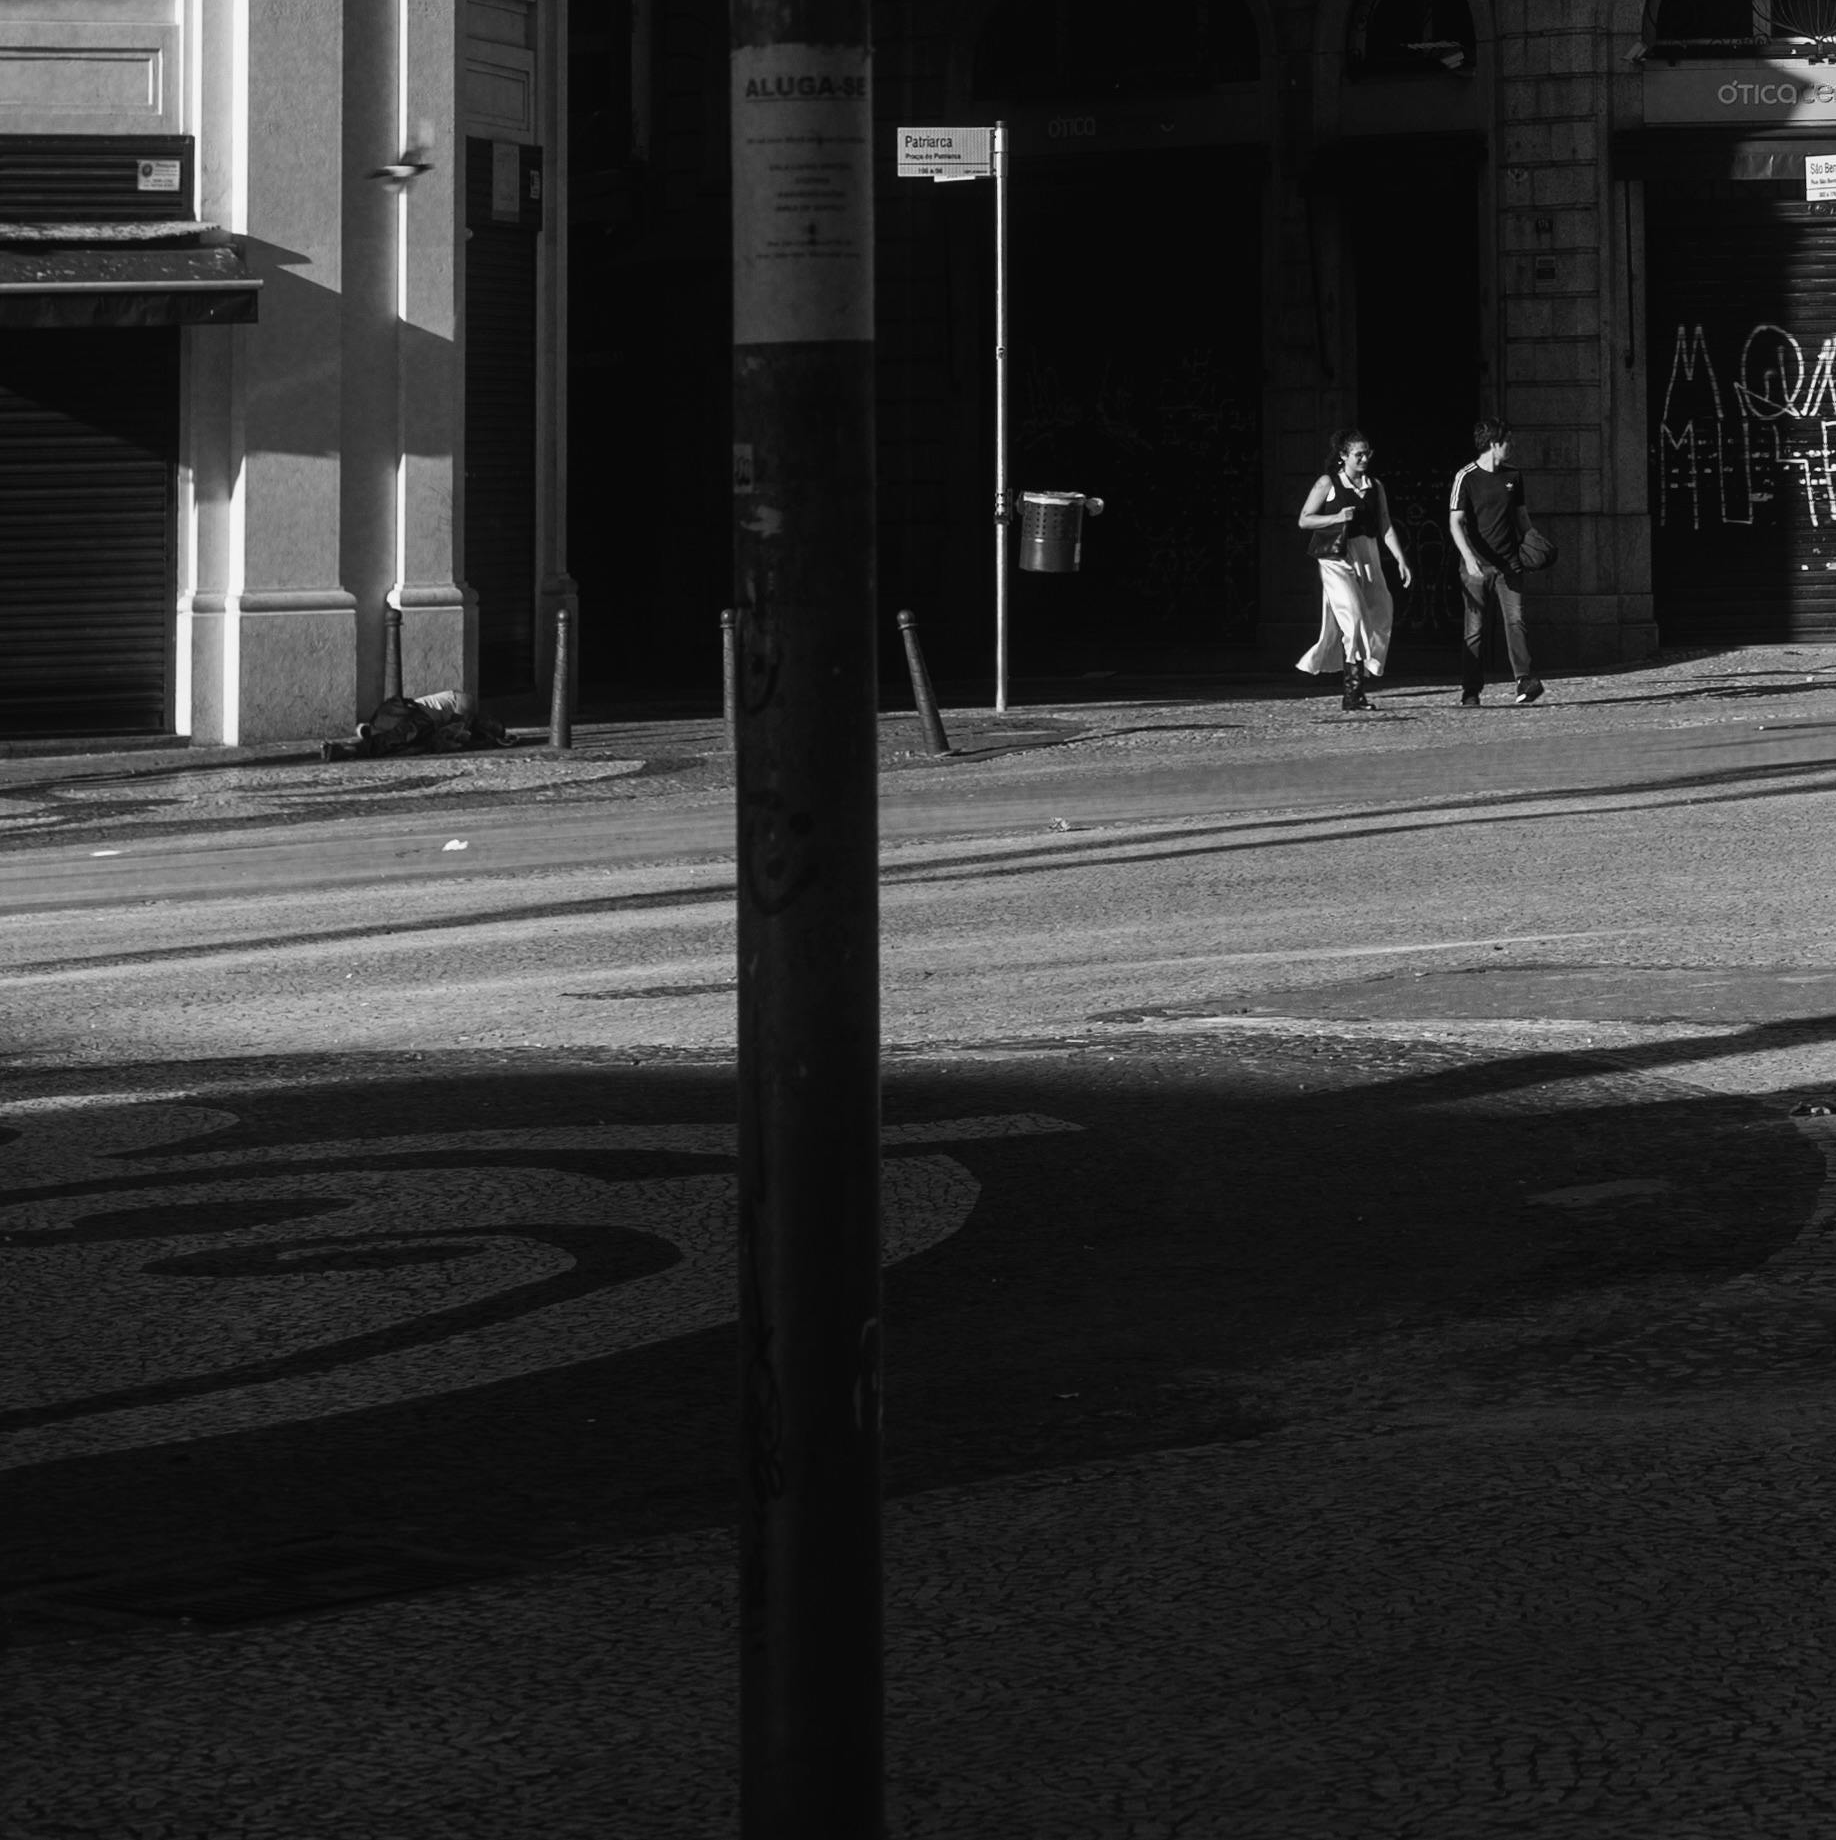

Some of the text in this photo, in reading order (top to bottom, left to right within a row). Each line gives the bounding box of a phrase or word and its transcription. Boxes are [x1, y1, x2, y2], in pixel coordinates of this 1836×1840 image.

[745, 76, 866, 98] ALUGA-SE
[904, 135, 953, 148] Patriarca
[1810, 163, 1823, 175] São
